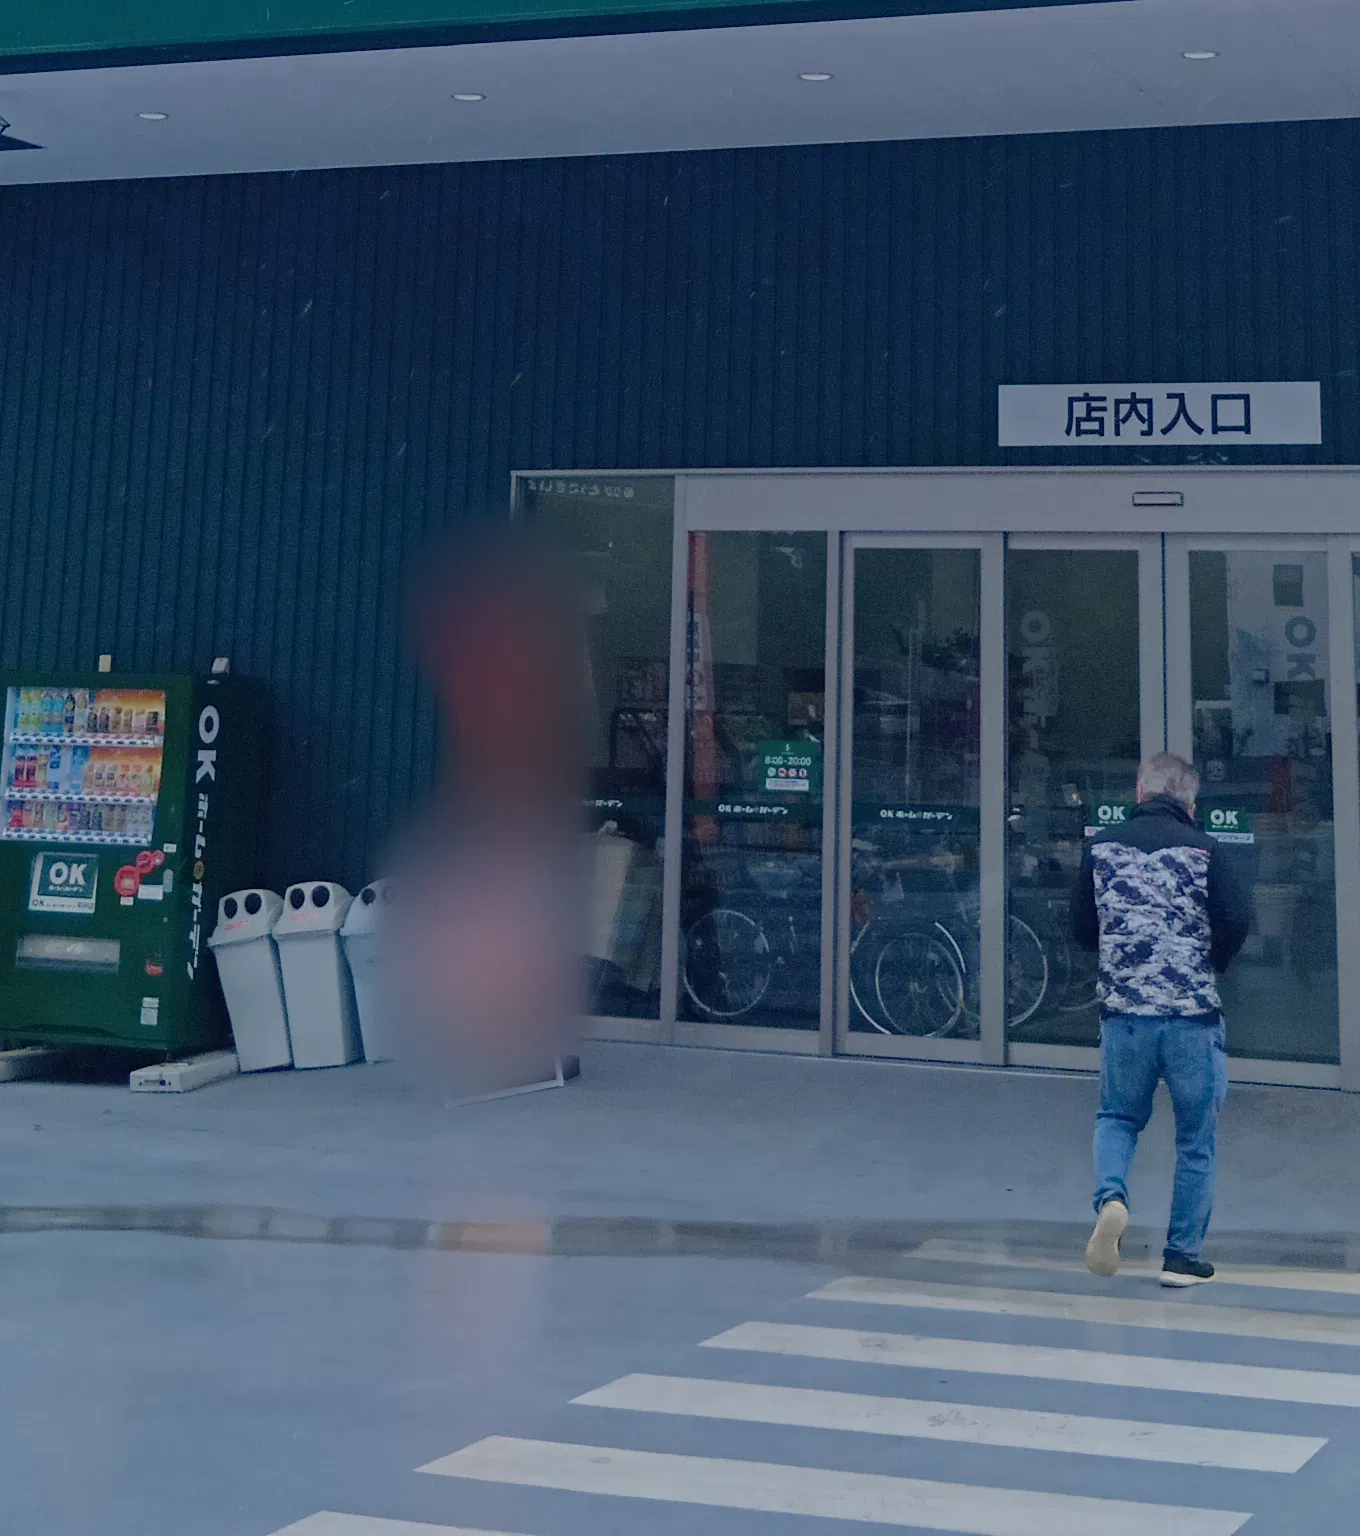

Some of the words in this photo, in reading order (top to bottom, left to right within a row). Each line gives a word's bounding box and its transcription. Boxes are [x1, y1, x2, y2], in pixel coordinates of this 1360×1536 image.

[1064, 391, 1252, 437] 店内入口
[195, 705, 220, 785] OK
[1097, 805, 1126, 821] OK
[1209, 809, 1239, 825] OK
[49, 861, 88, 885] OK
